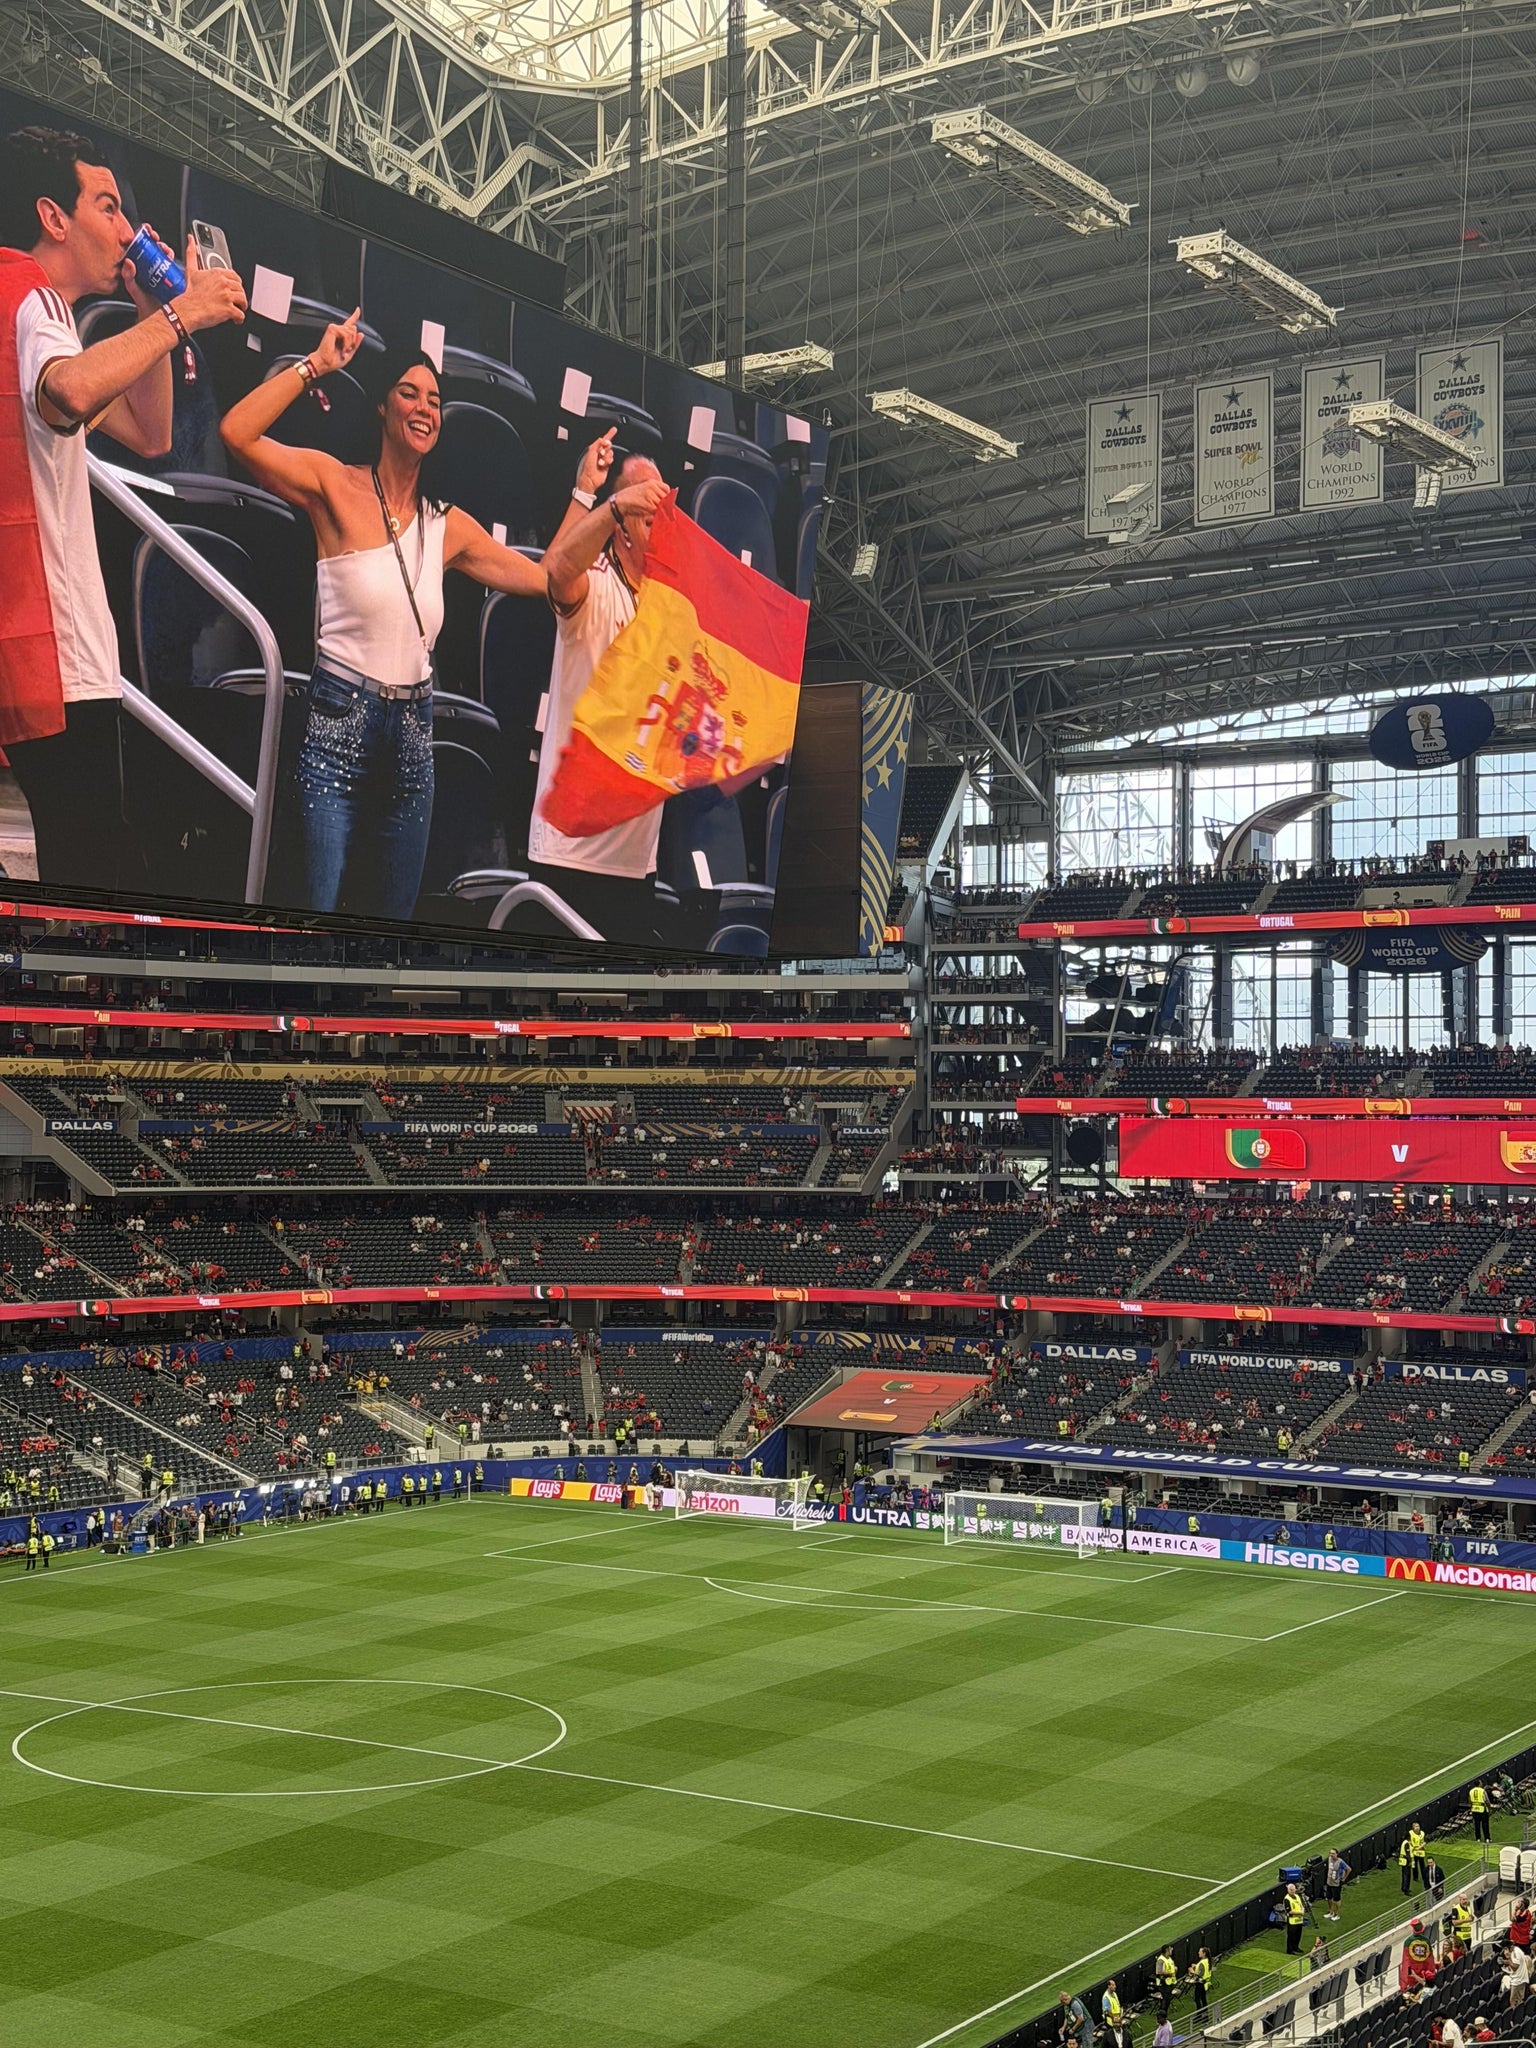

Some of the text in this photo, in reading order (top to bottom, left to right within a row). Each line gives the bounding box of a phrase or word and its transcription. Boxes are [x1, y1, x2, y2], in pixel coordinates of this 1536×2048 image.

[149, 259, 172, 288] ULTRA
[1438, 374, 1480, 389] DALLAS
[1322, 391, 1363, 405] DALLAS
[1433, 385, 1485, 401] COWBOYS
[1214, 408, 1253, 423] DALLAS
[1105, 425, 1142, 438] DALLAS
[1210, 419, 1258, 435] COWBOYS
[1101, 435, 1147, 449] COWBOYS
[1204, 442, 1263, 459] SUPER BOWL
[1093, 464, 1119, 473] SUPER
[1120, 462, 1142, 471] BOWL
[1320, 462, 1363, 475] WORLD
[1213, 476, 1254, 491] WORLD
[1307, 473, 1376, 489] CHAMPIONS
[1201, 487, 1267, 505] CHAMPIONS
[1329, 487, 1354, 500] 1992
[1223, 502, 1247, 515] 1977
[1390, 938, 1416, 947] FIFA
[1372, 947, 1439, 957] WORLD CUP
[1386, 957, 1428, 966] 2026
[51, 1121, 113, 1130] DALLAS
[404, 1123, 429, 1133] FIFA
[474, 1123, 496, 1133] CUP
[498, 1124, 538, 1133] 2026
[843, 1127, 889, 1135] DALLAS
[1391, 1144, 1409, 1163] V
[662, 1332, 714, 1343] #FIFAWorldCup
[1046, 1344, 1137, 1362] DALLAS
[1190, 1353, 1217, 1365] FIFA
[1219, 1354, 1265, 1368] WORLD
[1267, 1357, 1293, 1370] CUP
[1402, 1364, 1509, 1383] DALLAS
[1023, 1442, 1497, 1486] FIFA WORLD CUP 2026
[532, 1479, 561, 1498] Lay's
[595, 1484, 622, 1503] Lay's
[688, 1491, 740, 1513] erizon
[852, 1507, 912, 1527] ULTRA
[1131, 1535, 1198, 1552] AMERICA
[1466, 1541, 1499, 1556] FIFA
[1245, 1542, 1360, 1574] Hisense
